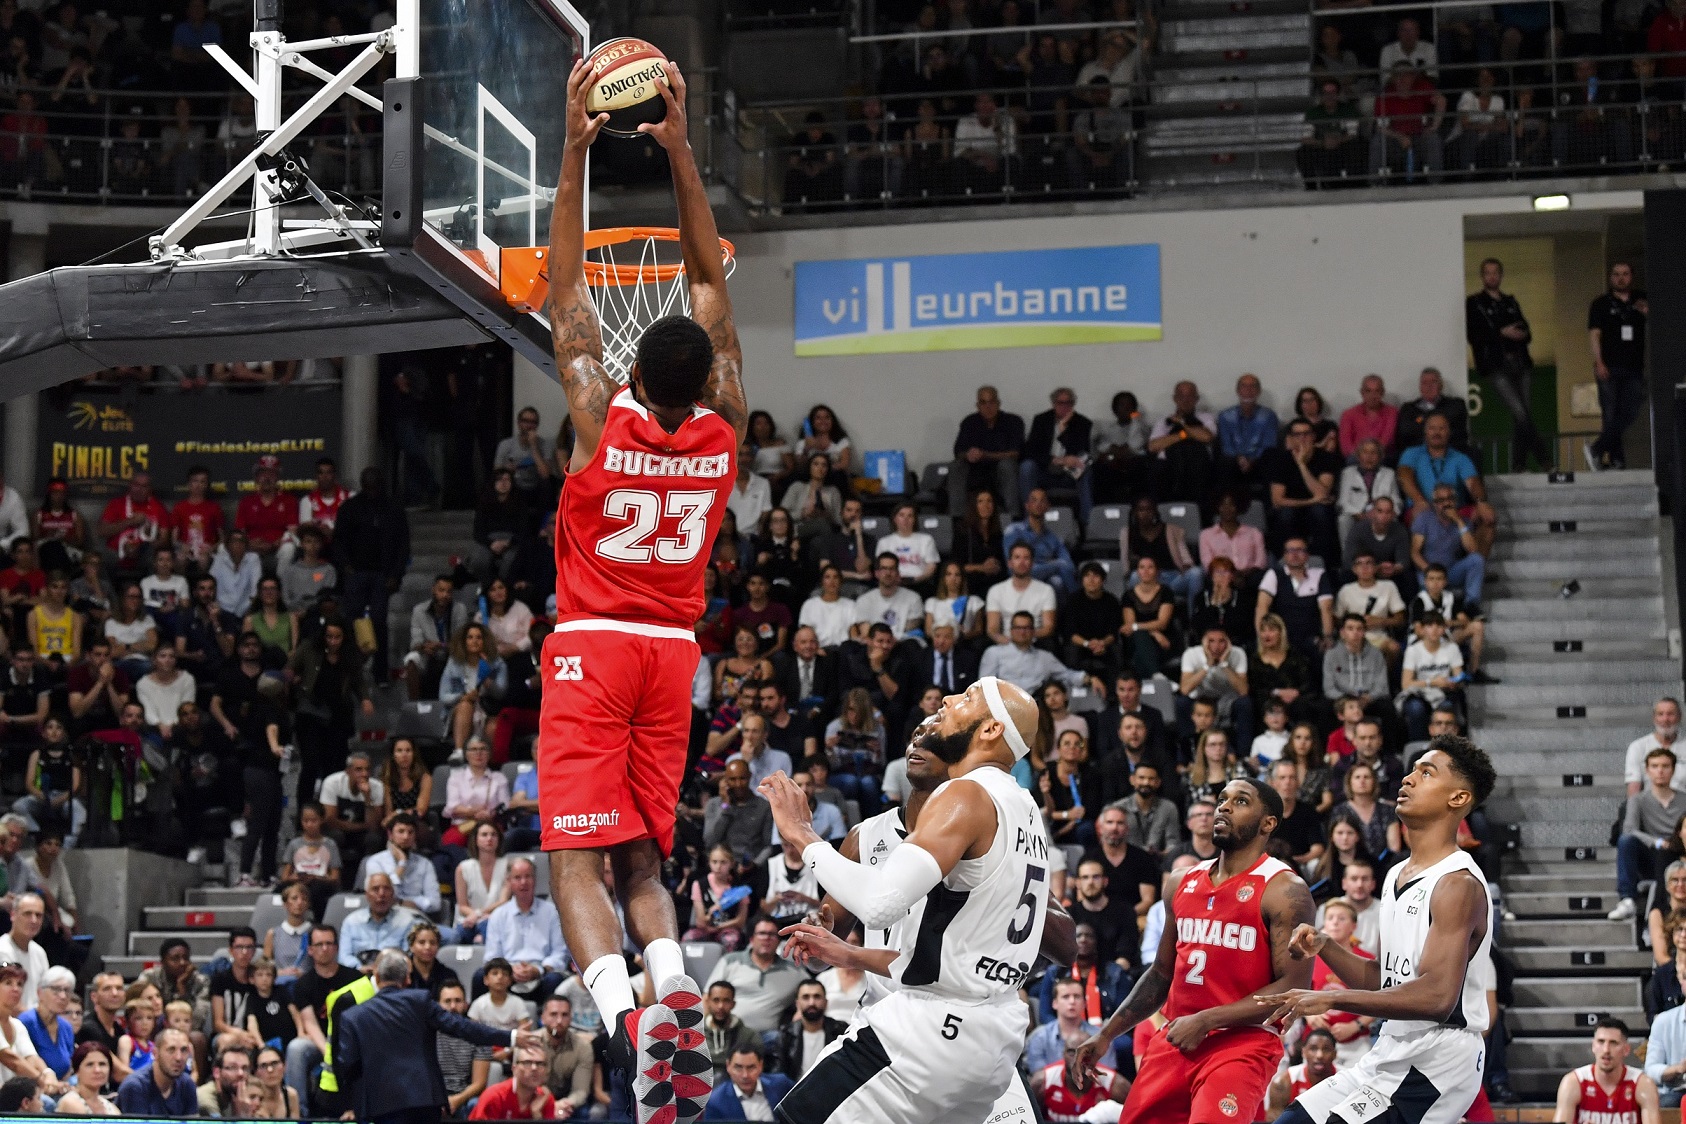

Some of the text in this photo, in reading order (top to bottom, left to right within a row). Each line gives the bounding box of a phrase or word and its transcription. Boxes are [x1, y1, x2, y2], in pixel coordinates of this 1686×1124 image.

[600, 61, 666, 101] SPALDING
[822, 261, 1127, 333] villeurbanne
[52, 440, 150, 481] FINALES
[603, 445, 729, 478] BUCKNER
[594, 488, 718, 564] 23
[553, 655, 584, 681] 23
[553, 809, 620, 830] amazon.fr
[1006, 863, 1046, 945] 5
[1185, 949, 1208, 986] 2
[941, 1013, 963, 1041] 5
[1587, 1013, 1599, 1026] D
